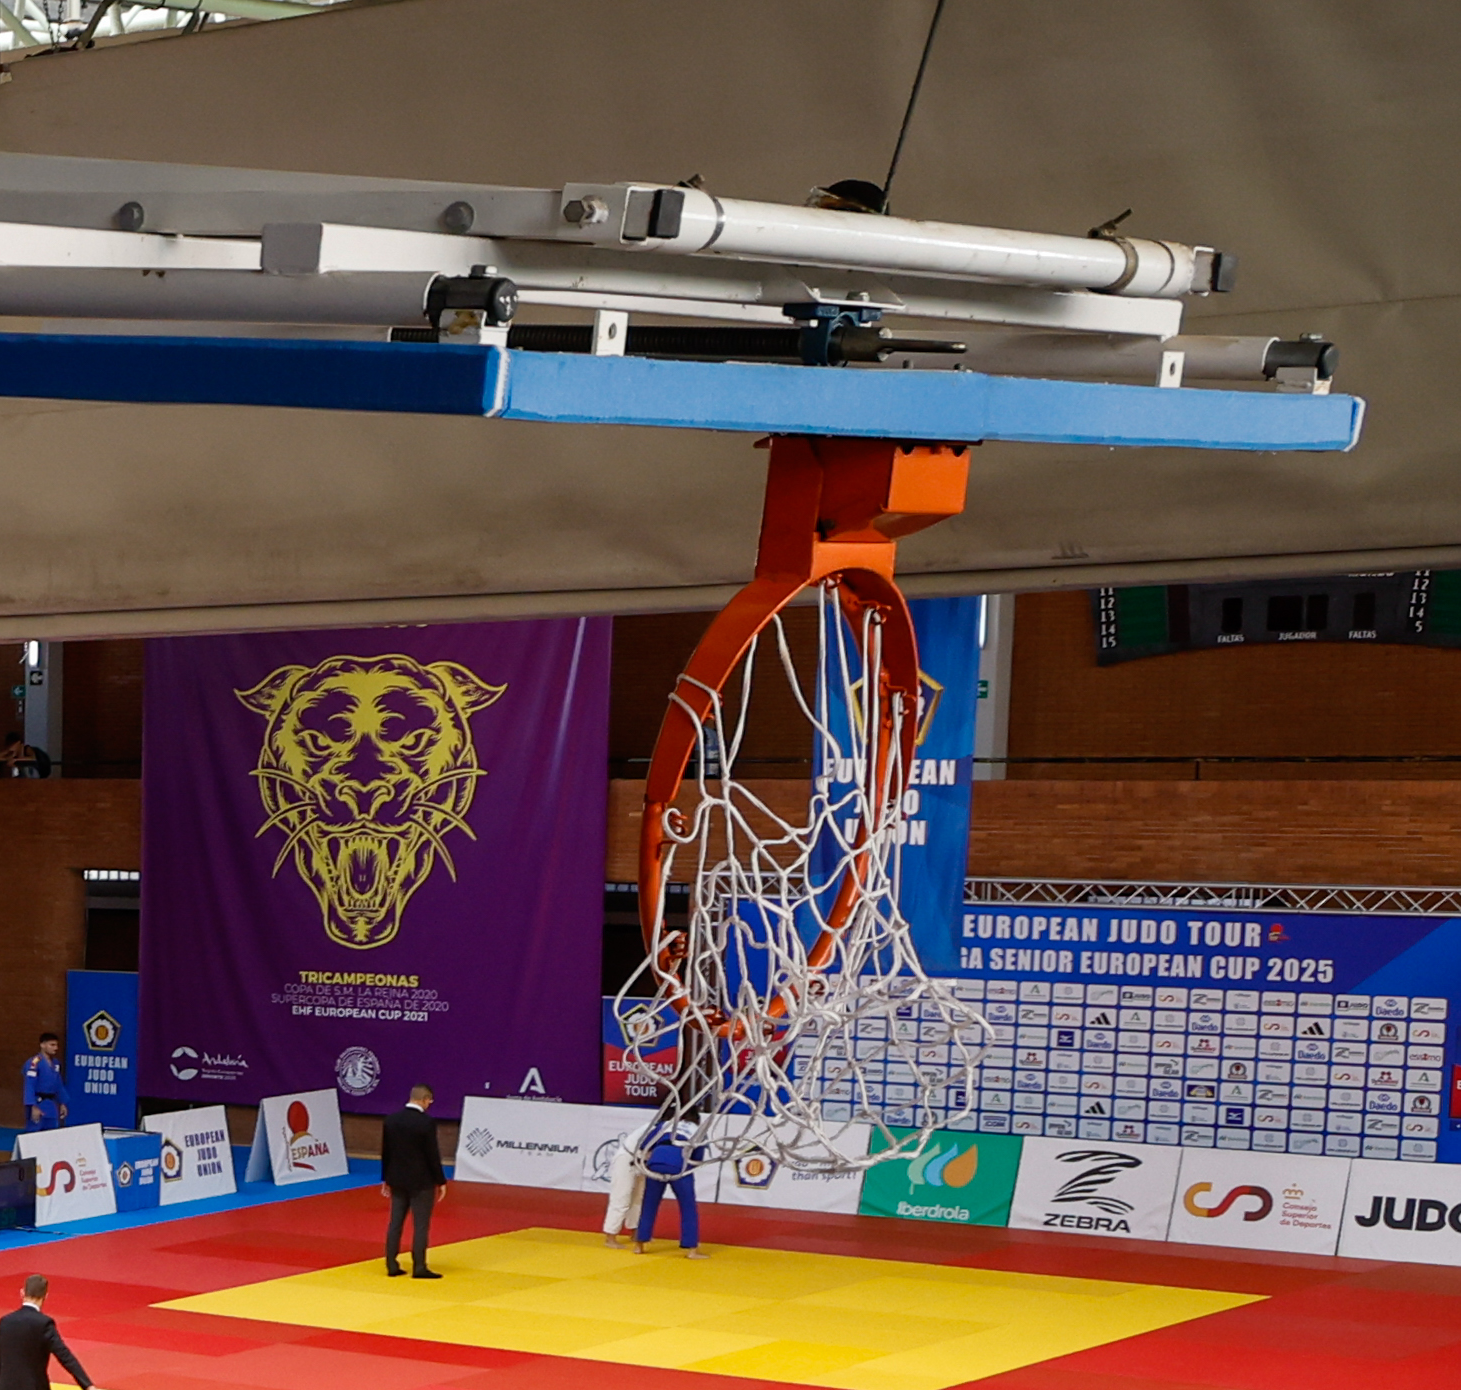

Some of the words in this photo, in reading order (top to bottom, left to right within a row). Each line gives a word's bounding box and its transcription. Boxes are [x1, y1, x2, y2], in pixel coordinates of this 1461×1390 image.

[1101, 636, 1117, 648] 15
[1217, 634, 1245, 644] FALTAS
[1348, 629, 1377, 640] FALTAS
[962, 914, 1098, 943] EUROPEAN
[1108, 916, 1177, 946] JUDO
[1187, 920, 1262, 948] TOUR
[989, 947, 1074, 974] SENIOR
[1080, 950, 1203, 980] EUROPEAN
[1210, 955, 1260, 982] CUP
[1267, 958, 1334, 984] 2025
[299, 971, 419, 987] TRICAMPEONAS
[284, 983, 313, 995] COPA
[316, 985, 332, 995] DE
[358, 987, 372, 997] LA
[374, 988, 409, 999] REINA
[411, 989, 438, 1000] 2020
[271, 993, 336, 1005] SUPERCOPA
[338, 996, 353, 1007] DE
[404, 1000, 419, 1010] DE
[422, 1001, 449, 1012] 2020
[292, 1006, 313, 1015] EHF
[315, 1007, 376, 1019] EUROPEAN
[379, 1009, 401, 1020] CUP
[403, 1011, 428, 1021] 2021
[75, 1054, 128, 1069] EUROPEAN
[624, 1084, 658, 1098] TOUR
[185, 1129, 225, 1147] EUROPEAN
[497, 1139, 579, 1154] MILLENNIUM
[896, 1200, 970, 1223] Iberdrola
[1281, 1210, 1318, 1220] Superior
[1283, 1202, 1317, 1214] Consejo
[1043, 1212, 1132, 1235] ZEBRA
